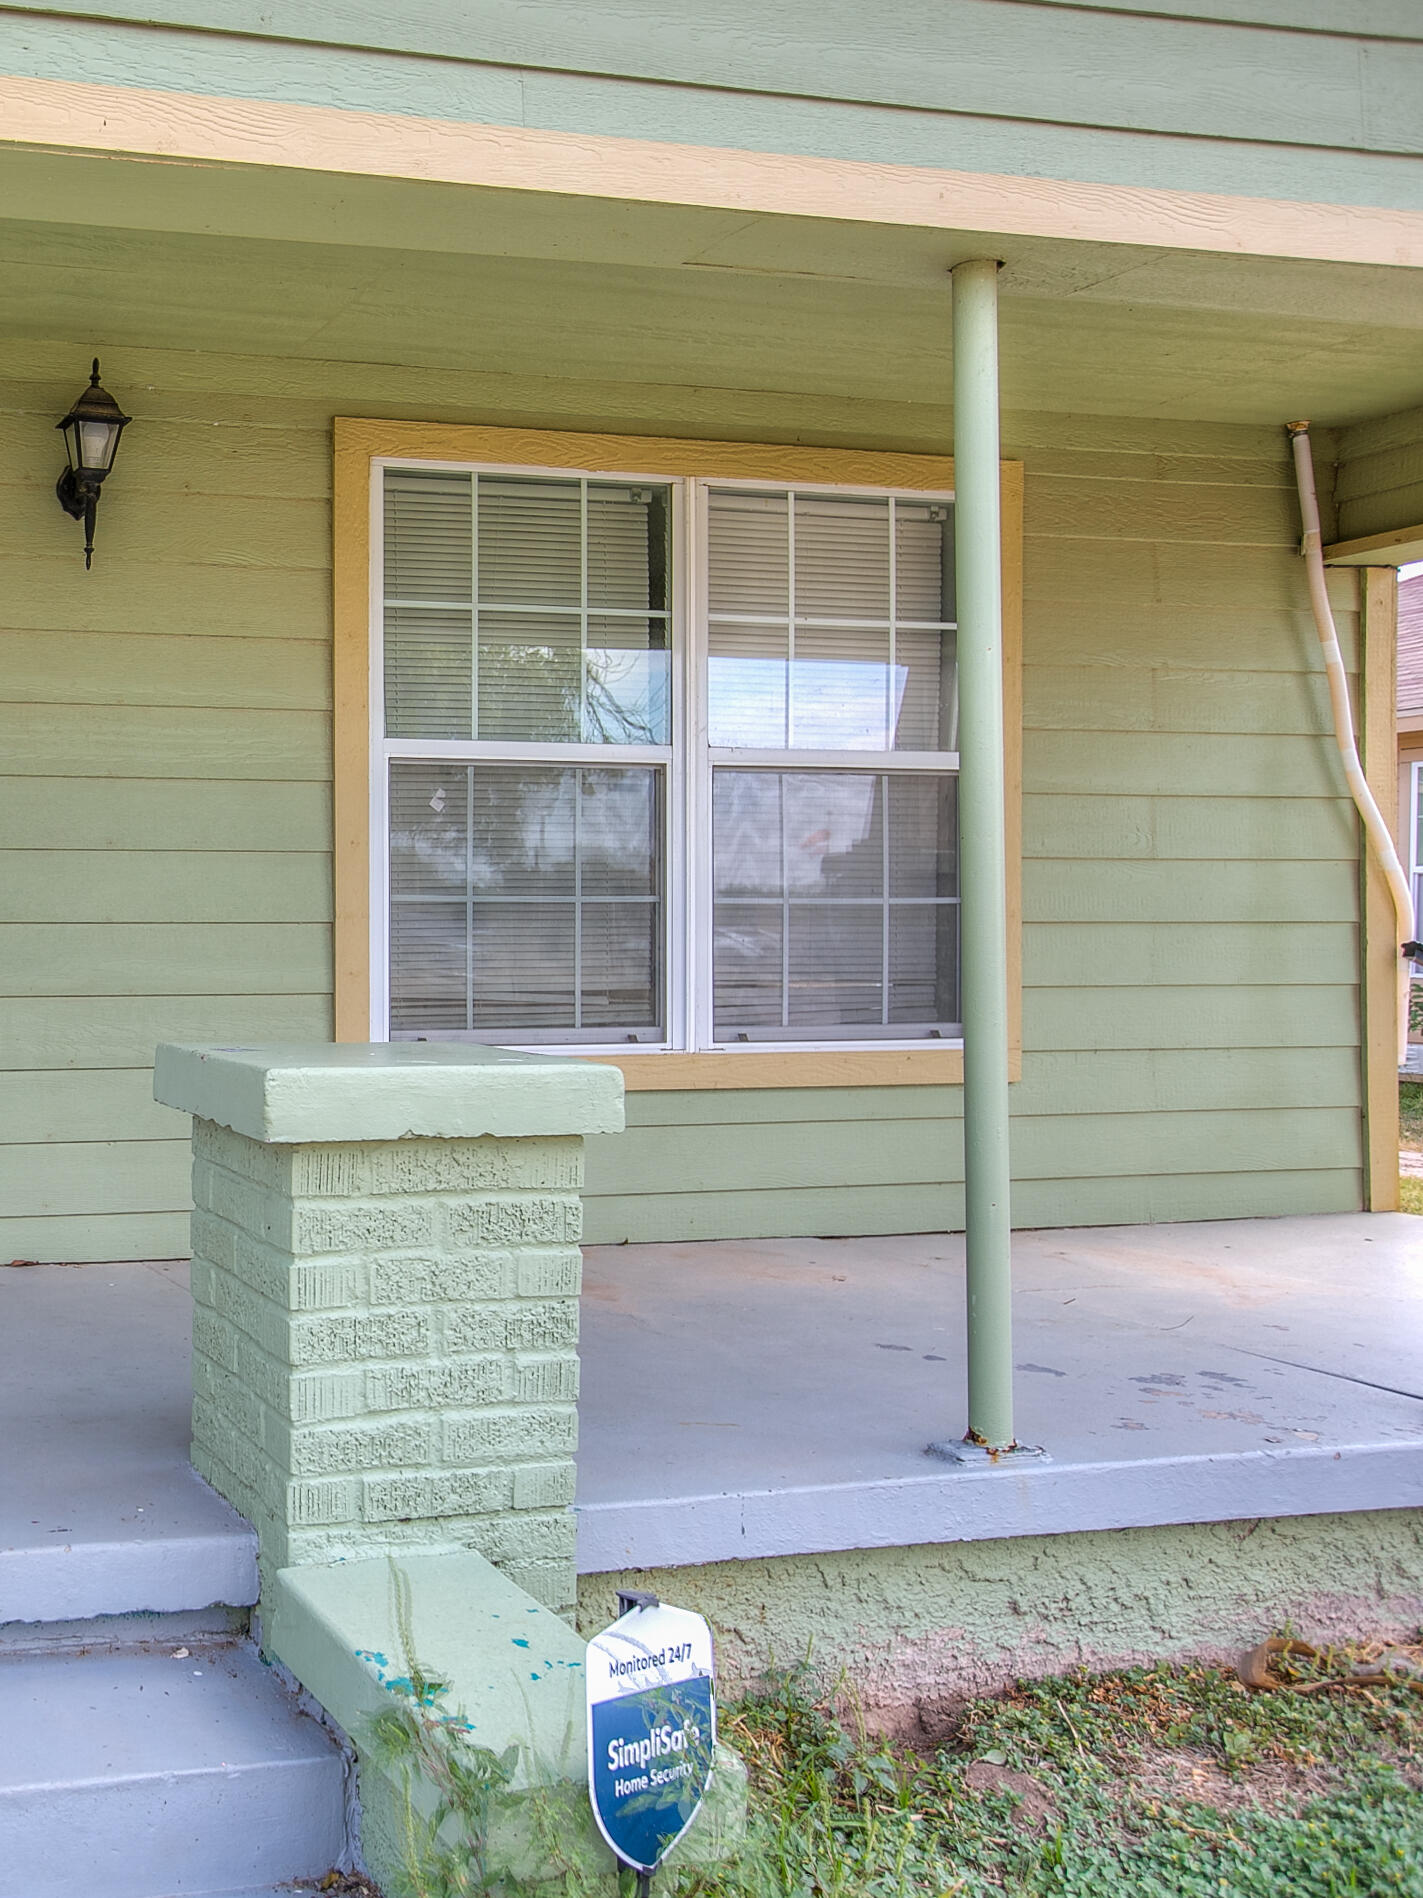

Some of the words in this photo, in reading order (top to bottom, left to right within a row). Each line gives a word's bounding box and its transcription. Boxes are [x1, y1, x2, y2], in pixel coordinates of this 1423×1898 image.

[609, 1648, 665, 1678] Monitored
[668, 1642, 692, 1663] 24/7
[614, 1775, 649, 1798] Home
[650, 1760, 694, 1786] Security
